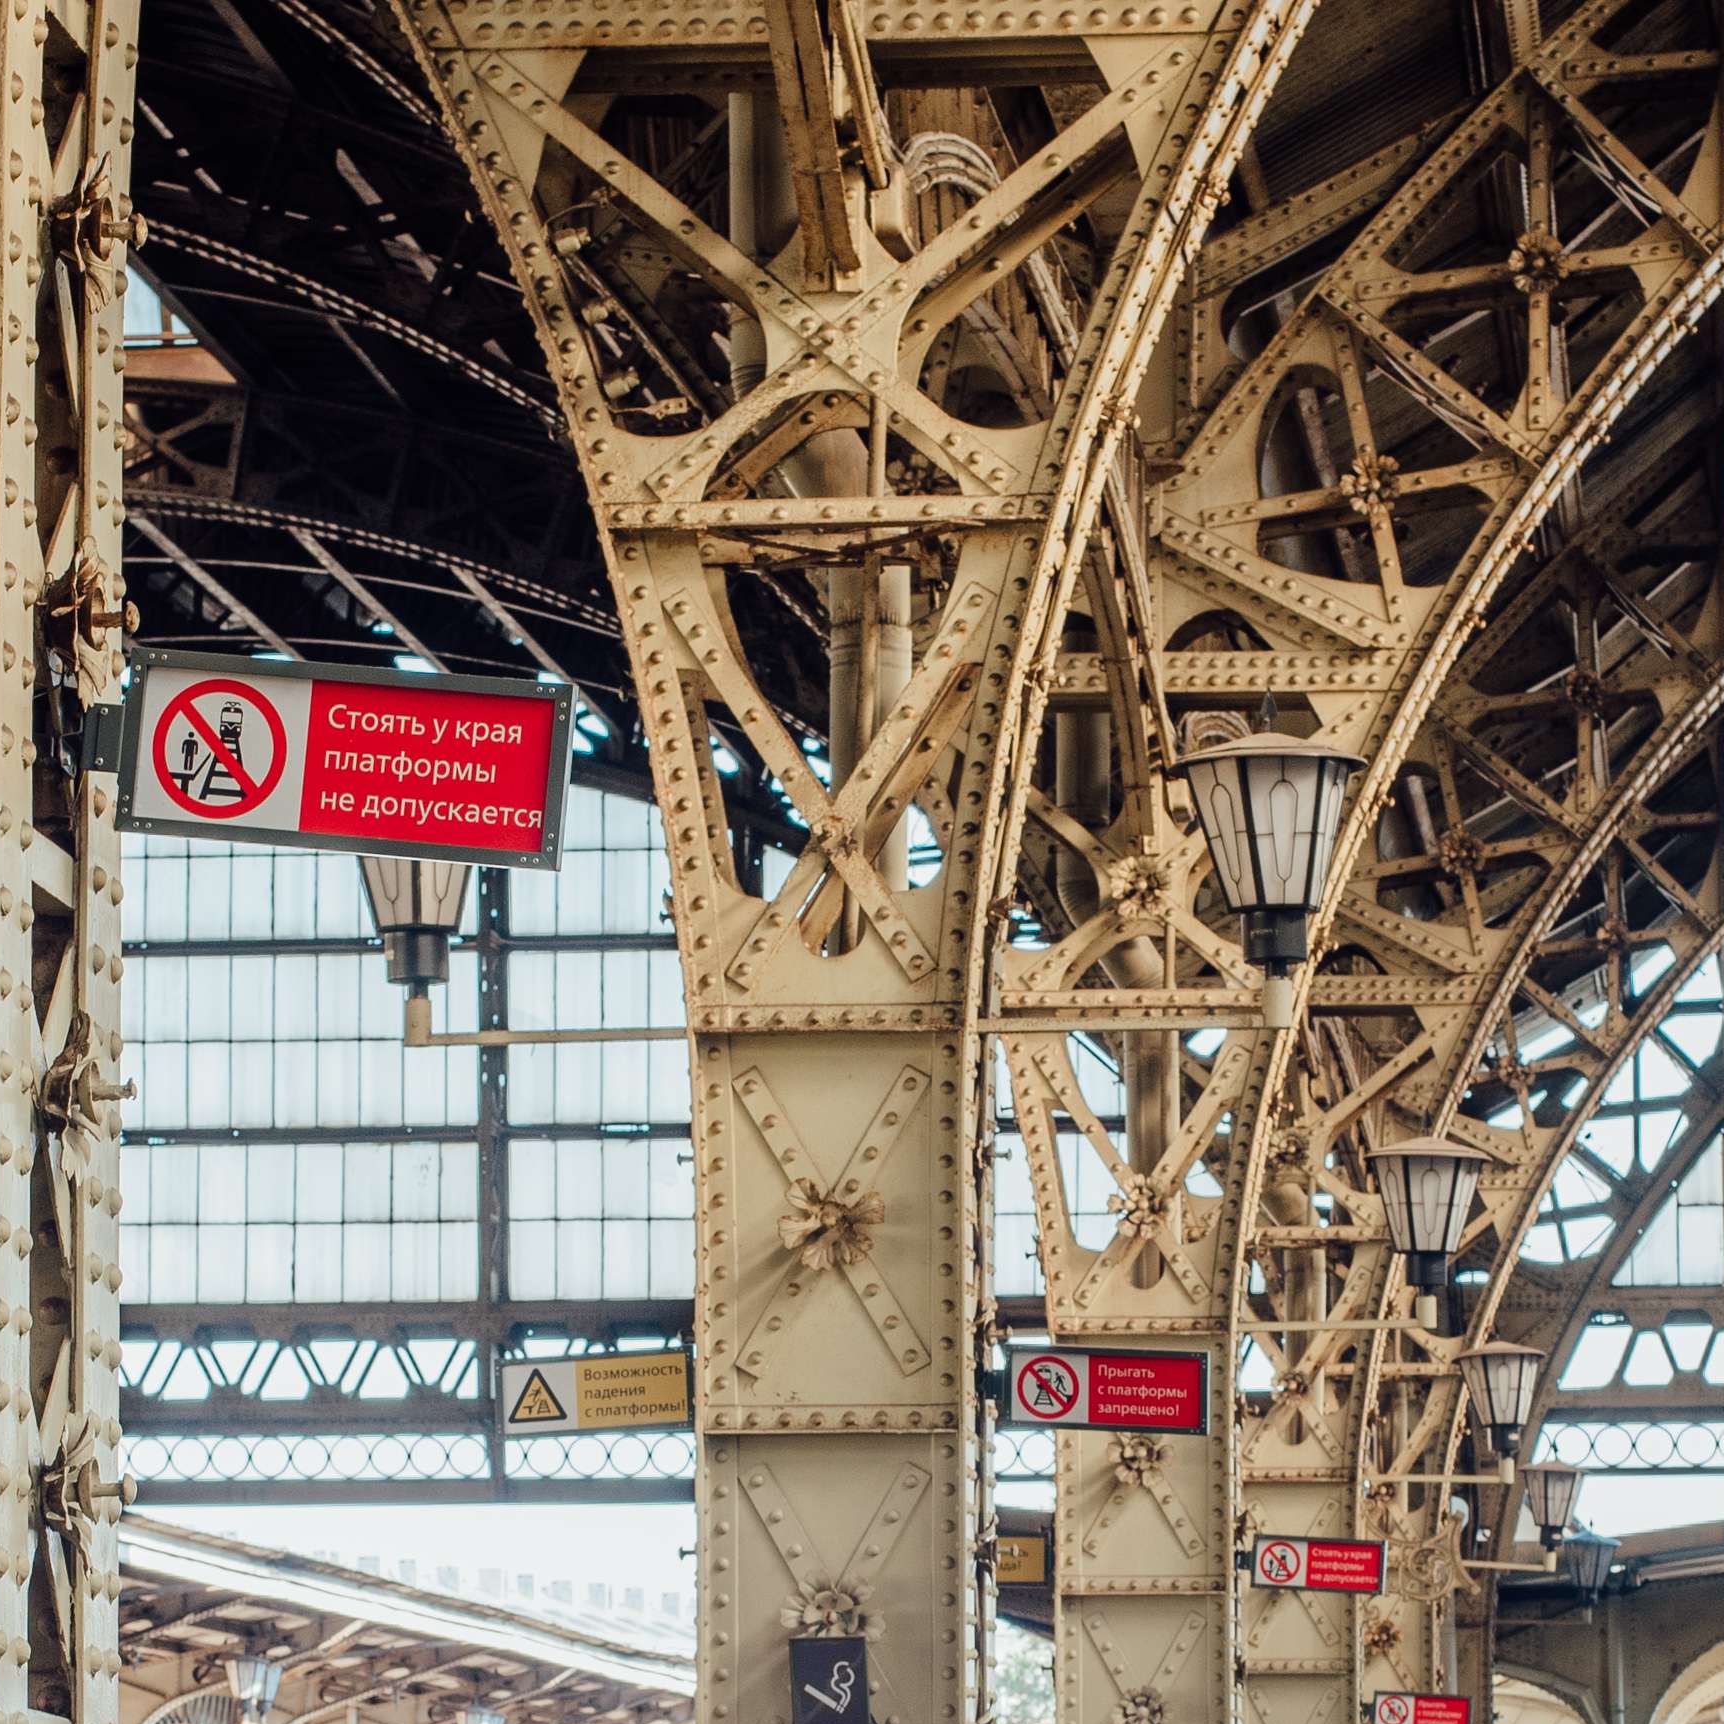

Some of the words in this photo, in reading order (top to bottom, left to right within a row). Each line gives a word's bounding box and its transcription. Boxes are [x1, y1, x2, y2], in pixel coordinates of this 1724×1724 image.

[327, 703, 426, 737] Стоять
[432, 716, 448, 745] у
[455, 719, 523, 747] края
[324, 749, 497, 786] платформы
[319, 787, 356, 813] не
[361, 793, 543, 830] допускается
[583, 1364, 684, 1382] Возможность
[1097, 1364, 1156, 1380] Прыгать
[584, 1385, 646, 1401] падения
[1107, 1384, 1188, 1400] платформы
[595, 1399, 687, 1418] платформы!
[1097, 1403, 1180, 1418] запрещено!
